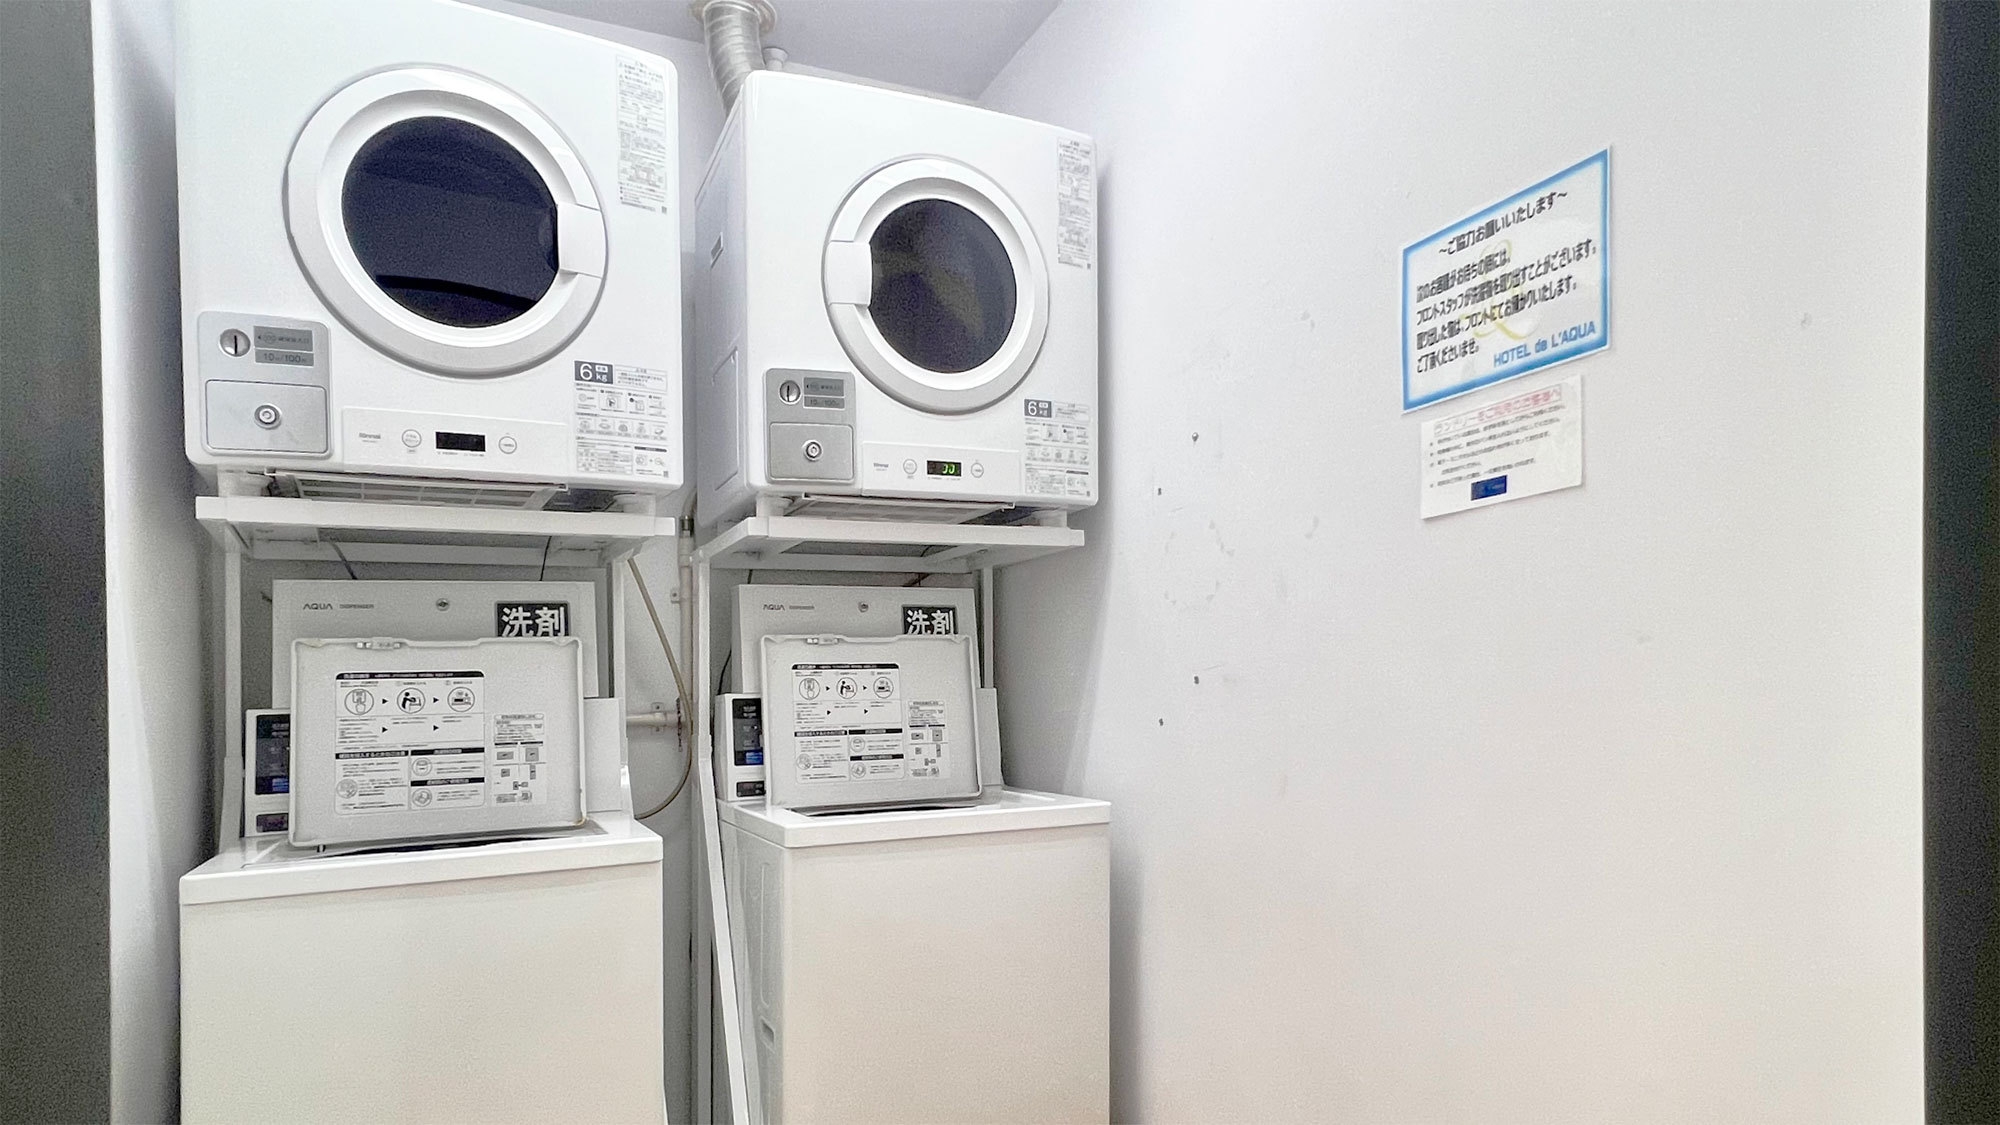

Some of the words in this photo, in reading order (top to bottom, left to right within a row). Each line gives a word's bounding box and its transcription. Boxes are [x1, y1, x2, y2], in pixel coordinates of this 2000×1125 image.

[1493, 343, 1531, 368] HOTEL
[1535, 338, 1548, 353] de
[580, 363, 593, 381] 6
[595, 372, 608, 382] kg
[1027, 400, 1038, 416] 6
[302, 603, 334, 611] AQUA
[762, 603, 786, 611] AQUA
[501, 606, 566, 638] 洗剤
[906, 609, 955, 635] 洗剤
